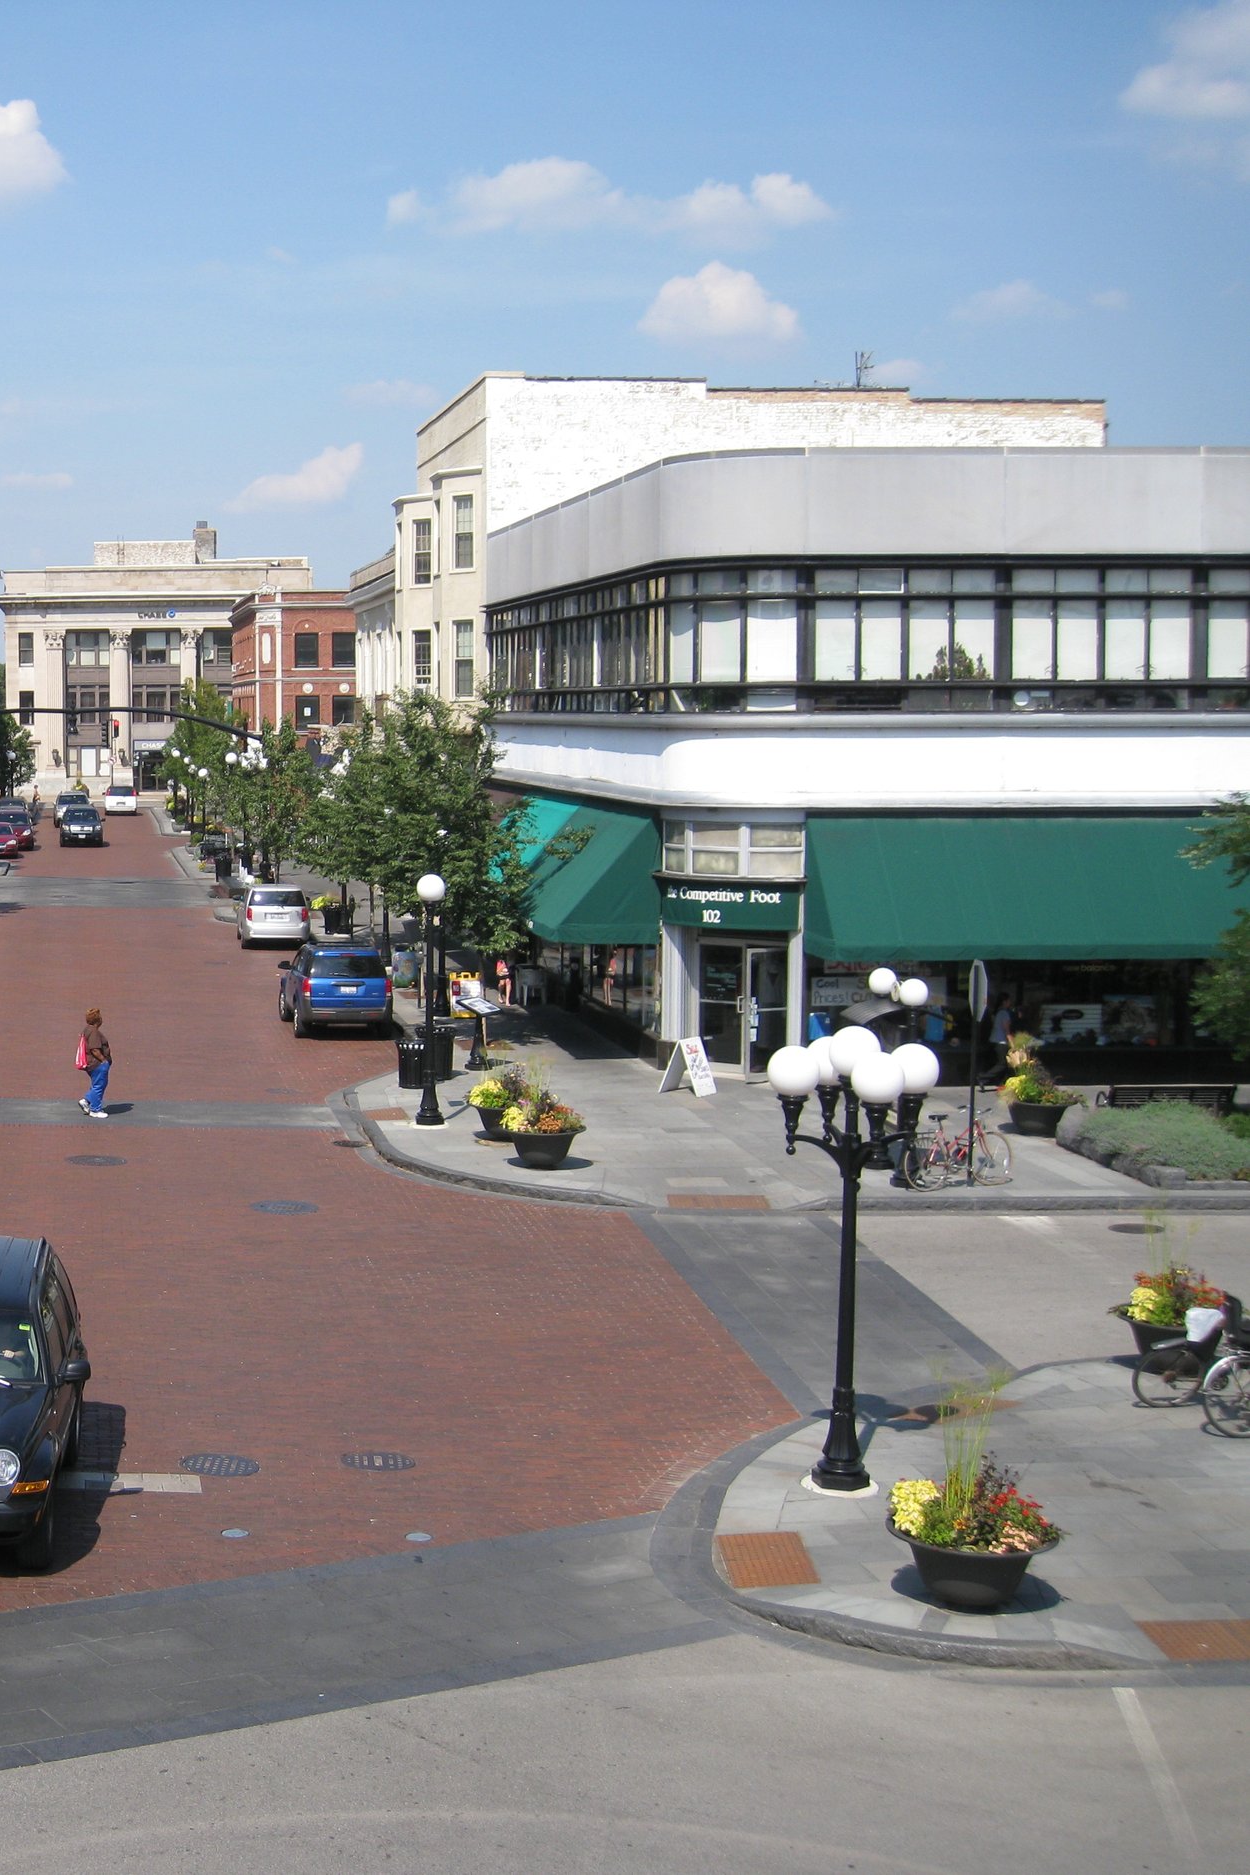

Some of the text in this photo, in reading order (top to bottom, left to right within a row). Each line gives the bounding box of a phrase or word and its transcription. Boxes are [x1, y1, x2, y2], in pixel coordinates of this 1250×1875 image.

[680, 886, 744, 904] Competitive
[749, 889, 782, 904] Foot
[702, 909, 721, 923] 102
